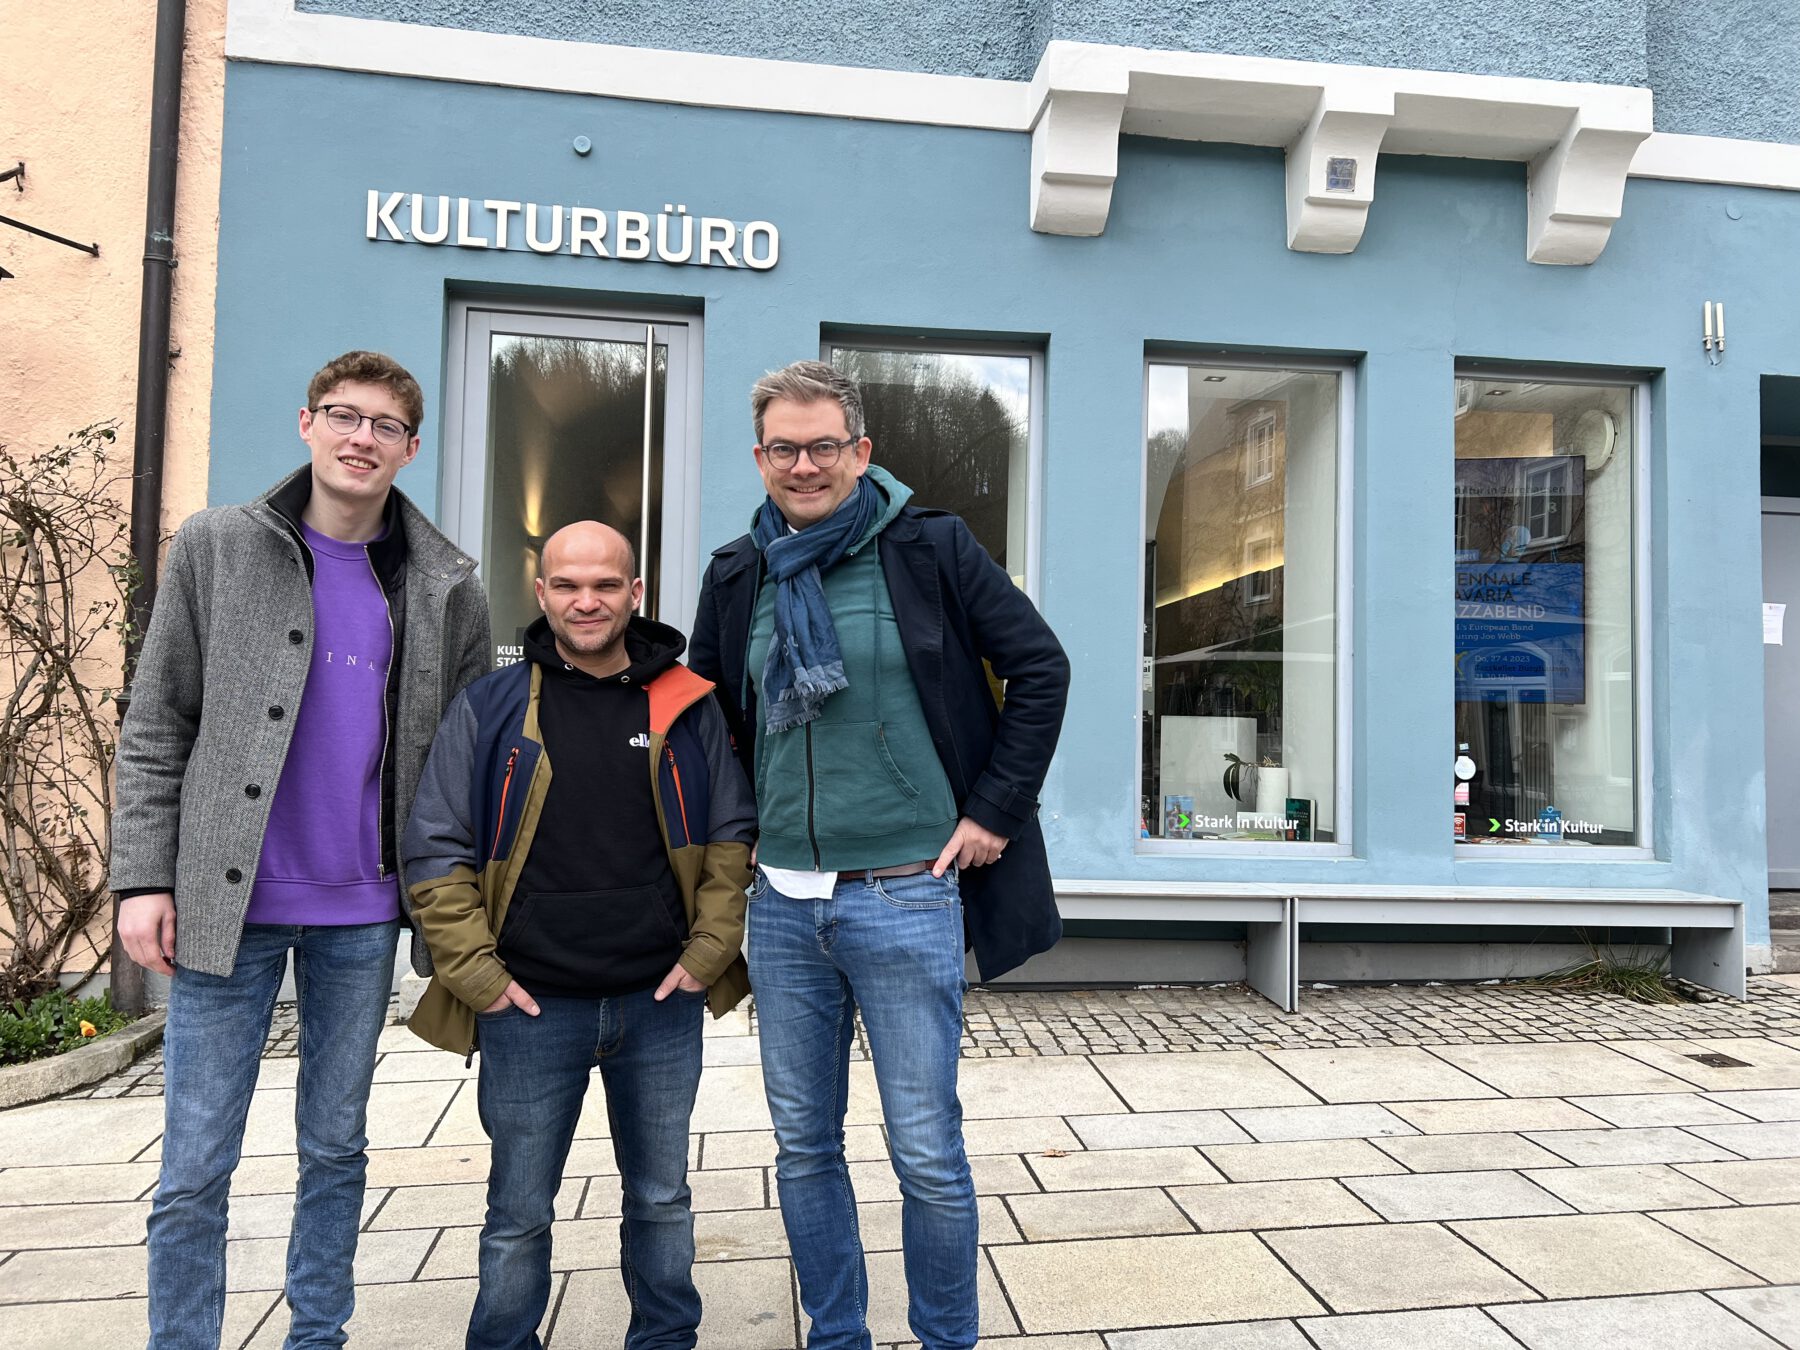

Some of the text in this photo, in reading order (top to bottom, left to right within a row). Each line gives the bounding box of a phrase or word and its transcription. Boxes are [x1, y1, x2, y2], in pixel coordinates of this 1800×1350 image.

[366, 189, 780, 270] KULTURBÜRO
[1194, 814, 1233, 829] Stark
[1236, 814, 1250, 829] in
[1253, 815, 1300, 830] Kultur
[1504, 818, 1604, 834] Stark in Kultur
